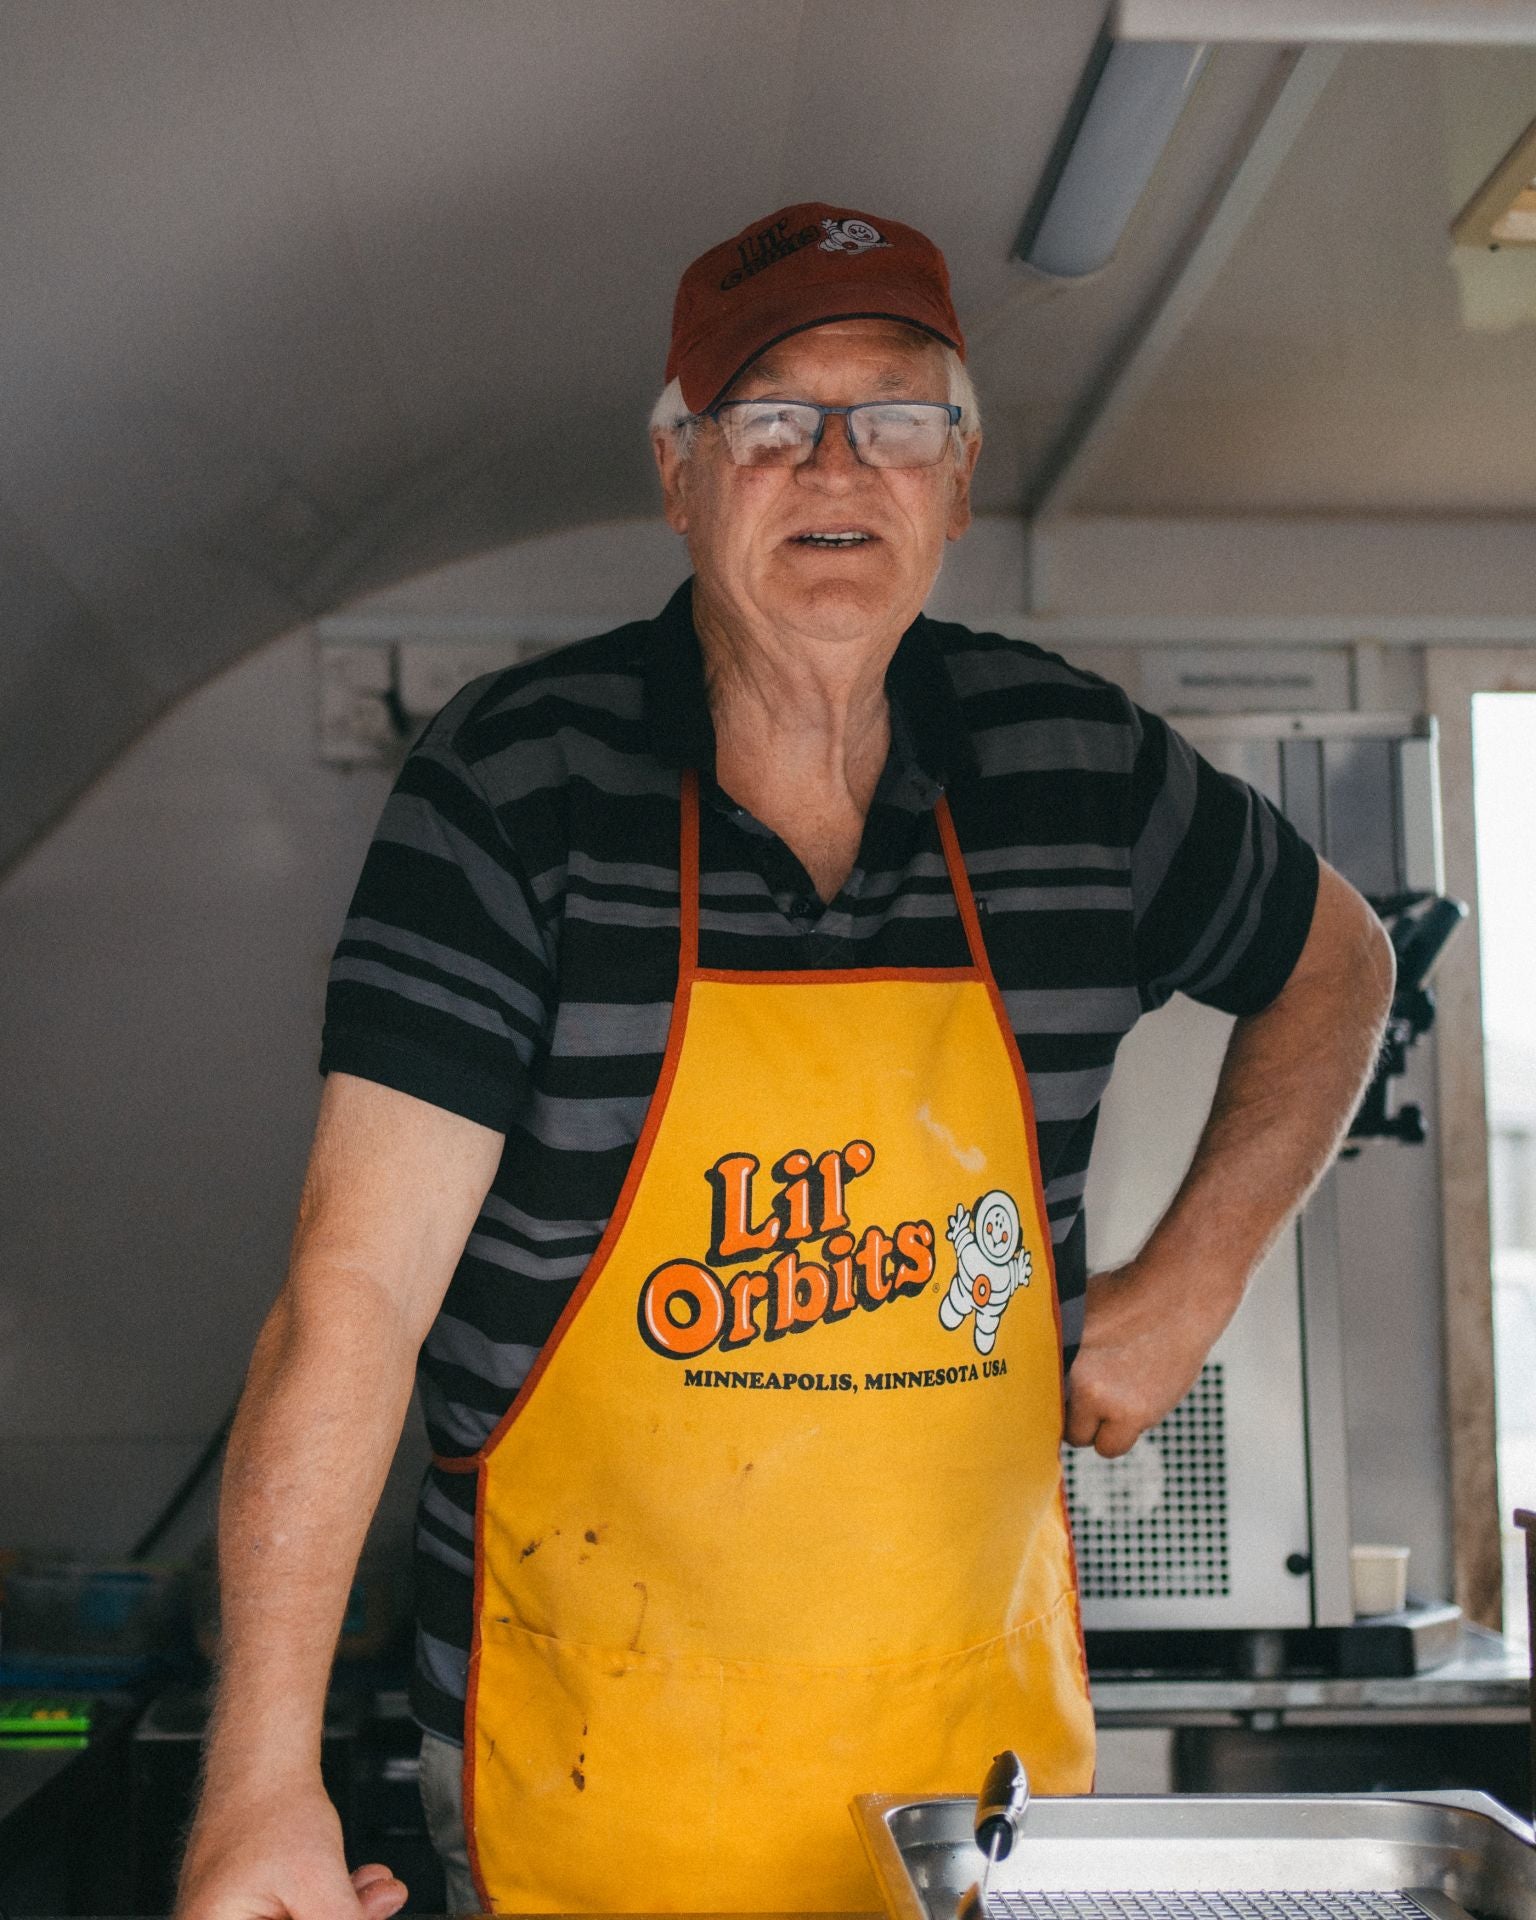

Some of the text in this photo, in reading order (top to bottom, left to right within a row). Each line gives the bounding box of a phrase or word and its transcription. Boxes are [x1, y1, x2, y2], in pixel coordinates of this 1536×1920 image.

[705, 1139, 875, 1266] Lil'
[637, 1219, 936, 1360] Orbits
[684, 1358, 1008, 1394] MINNEAPOLIS, MINNESOTA USA
